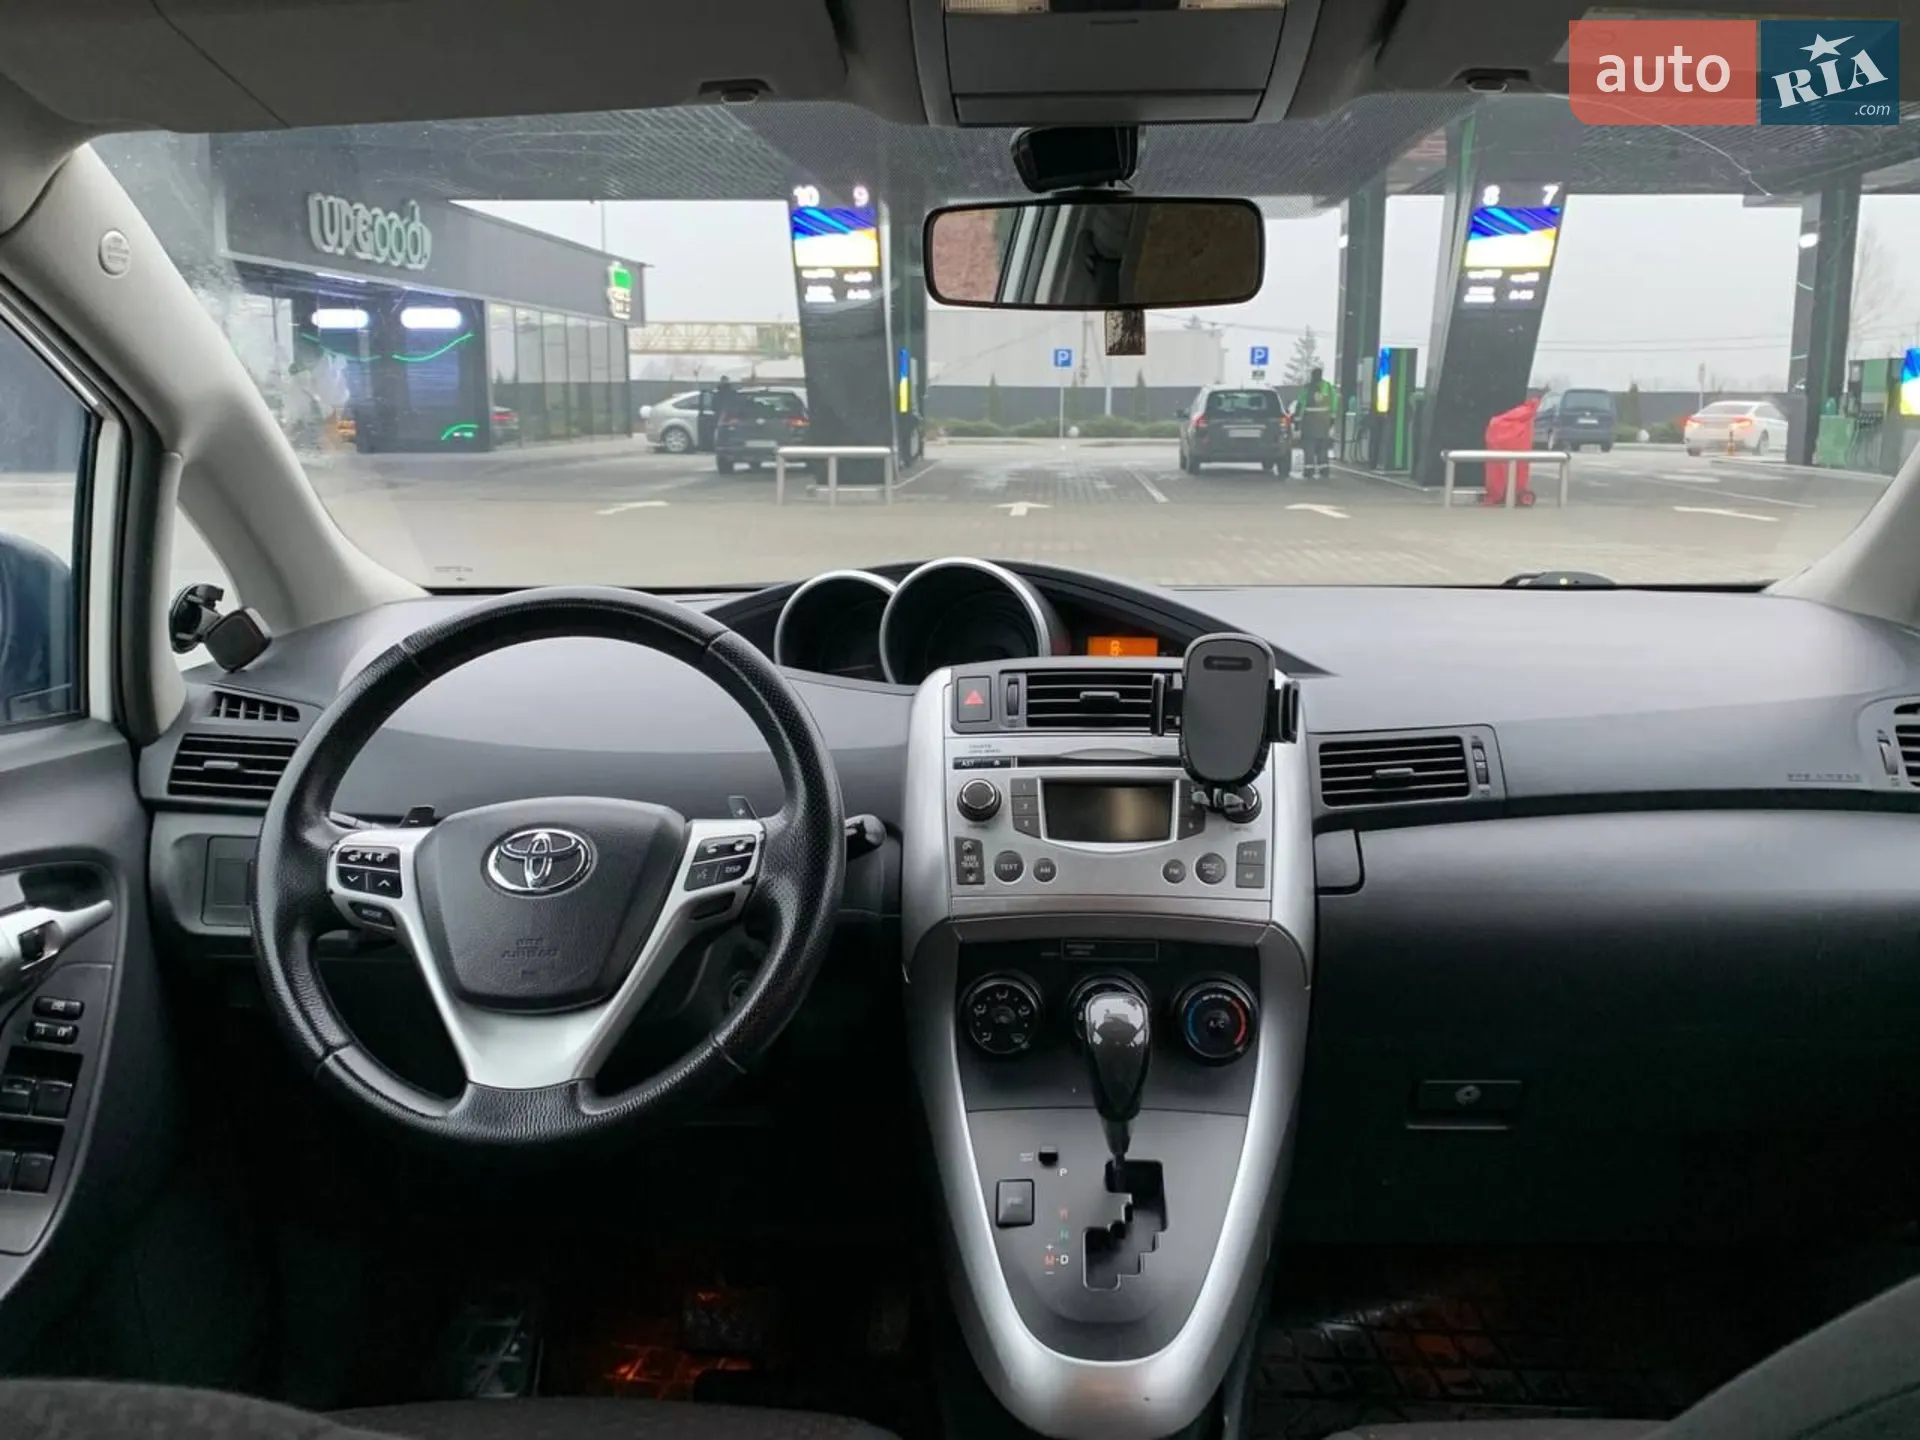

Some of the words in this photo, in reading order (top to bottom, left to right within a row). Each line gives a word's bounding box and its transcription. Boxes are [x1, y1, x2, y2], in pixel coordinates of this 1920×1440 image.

[793, 185, 819, 207] 10
[853, 185, 869, 207] 9
[1542, 184, 1559, 206] 7
[1000, 862, 1018, 871] TEXT
[1059, 1167, 1069, 1177] P
